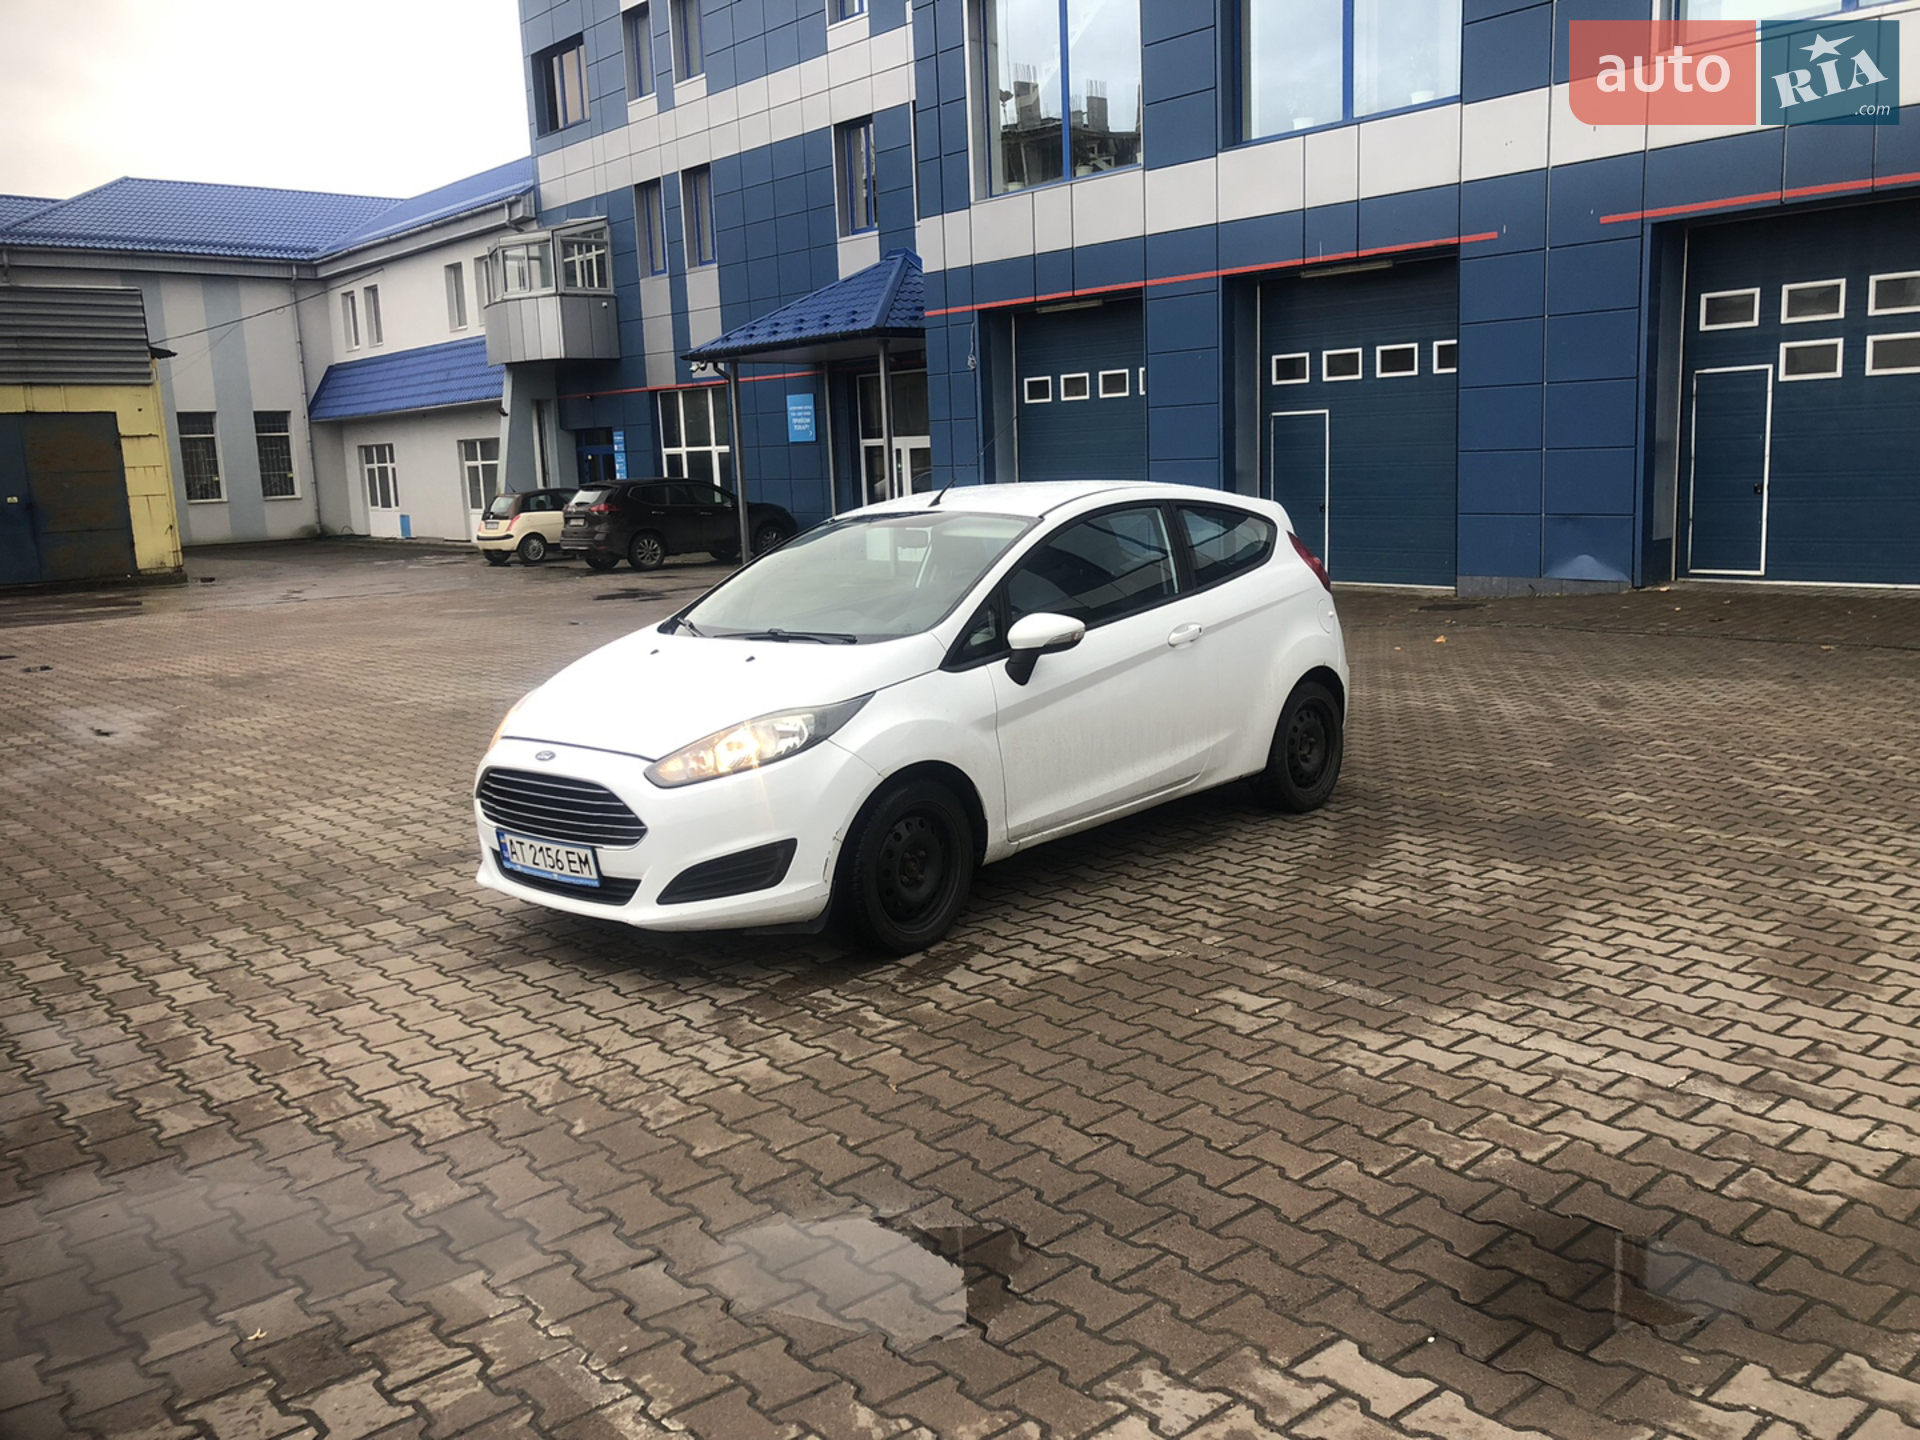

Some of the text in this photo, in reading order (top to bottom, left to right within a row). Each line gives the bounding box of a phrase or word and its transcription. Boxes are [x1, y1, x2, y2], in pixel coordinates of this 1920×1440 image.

[509, 839, 526, 863] AT
[529, 844, 564, 871] 2156
[565, 850, 592, 876] EM
